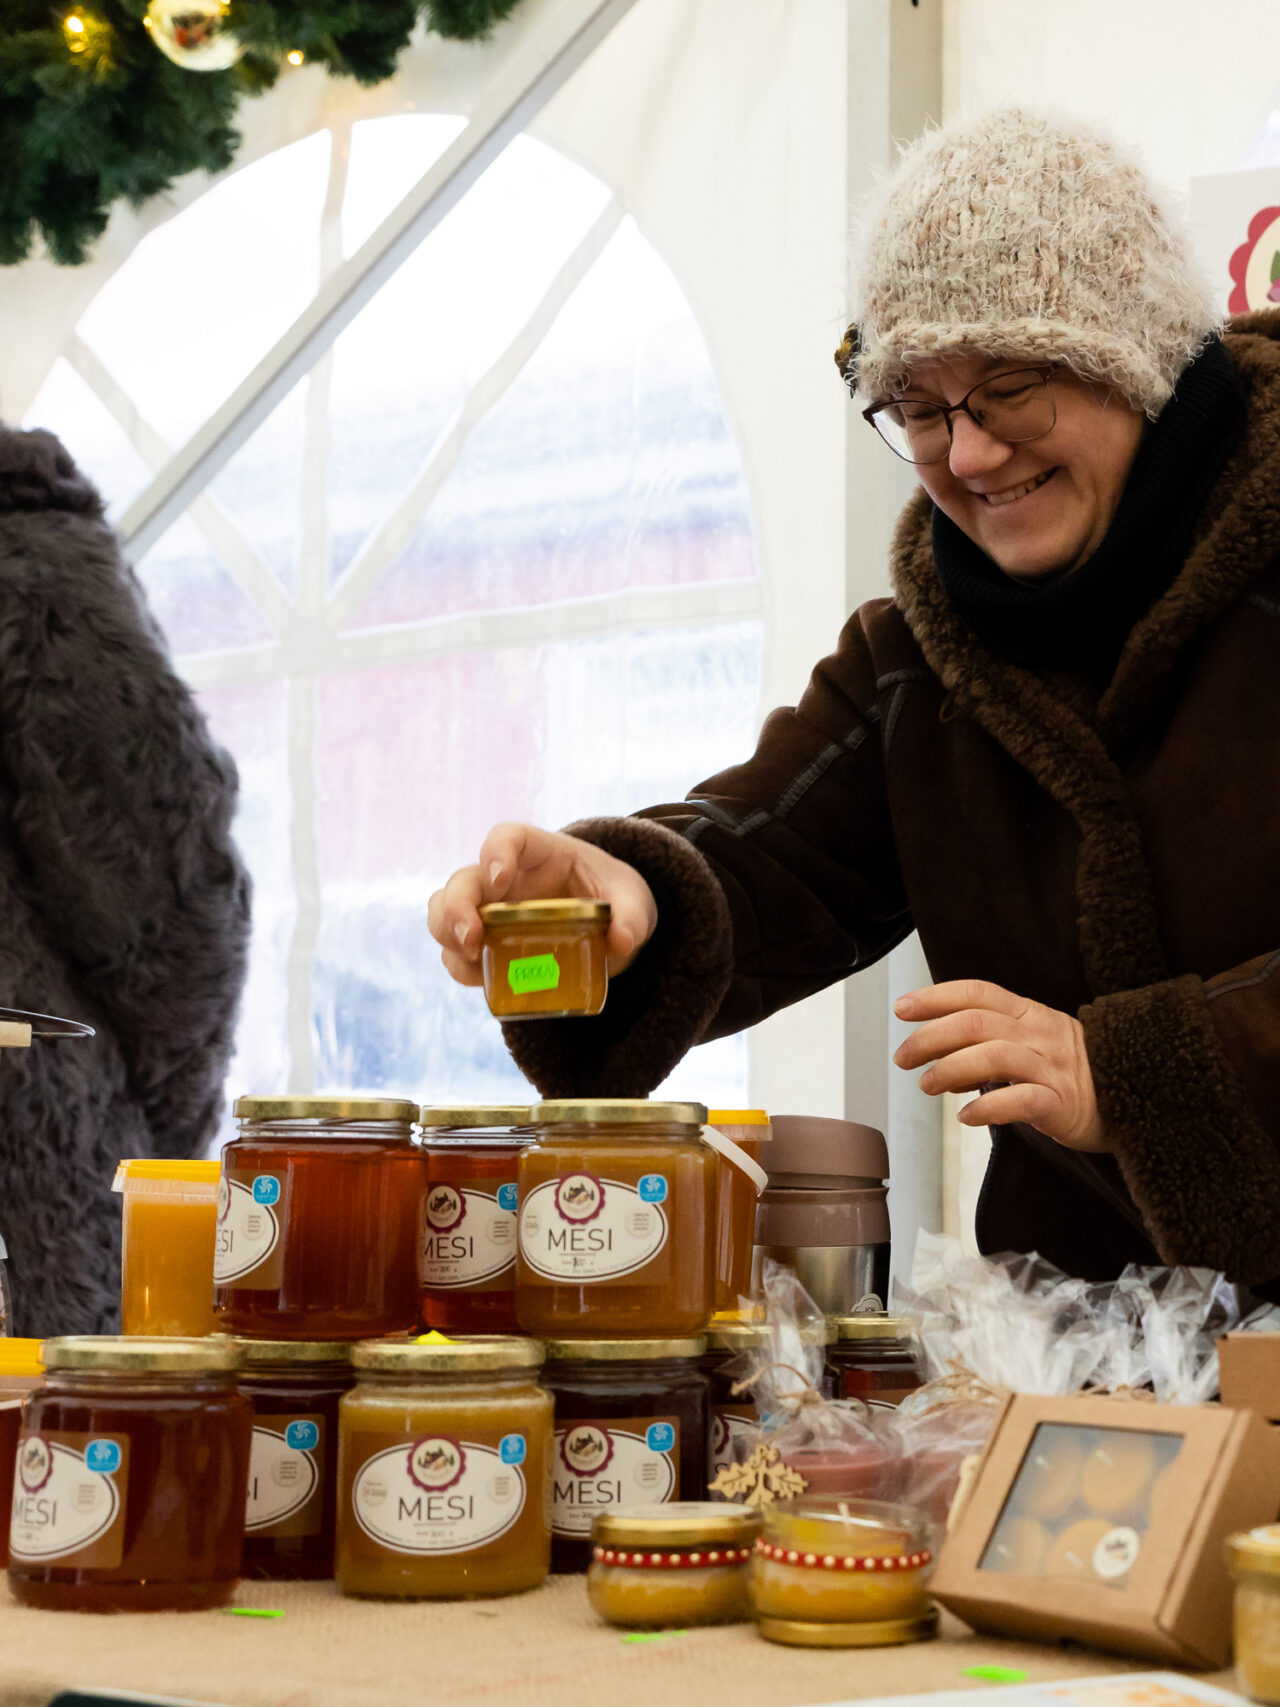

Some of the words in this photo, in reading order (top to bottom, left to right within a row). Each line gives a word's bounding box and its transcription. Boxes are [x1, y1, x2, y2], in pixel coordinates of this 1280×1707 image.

[547, 1227, 613, 1252] MESI
[553, 1480, 622, 1505] MESI
[397, 1494, 475, 1522] MESI
